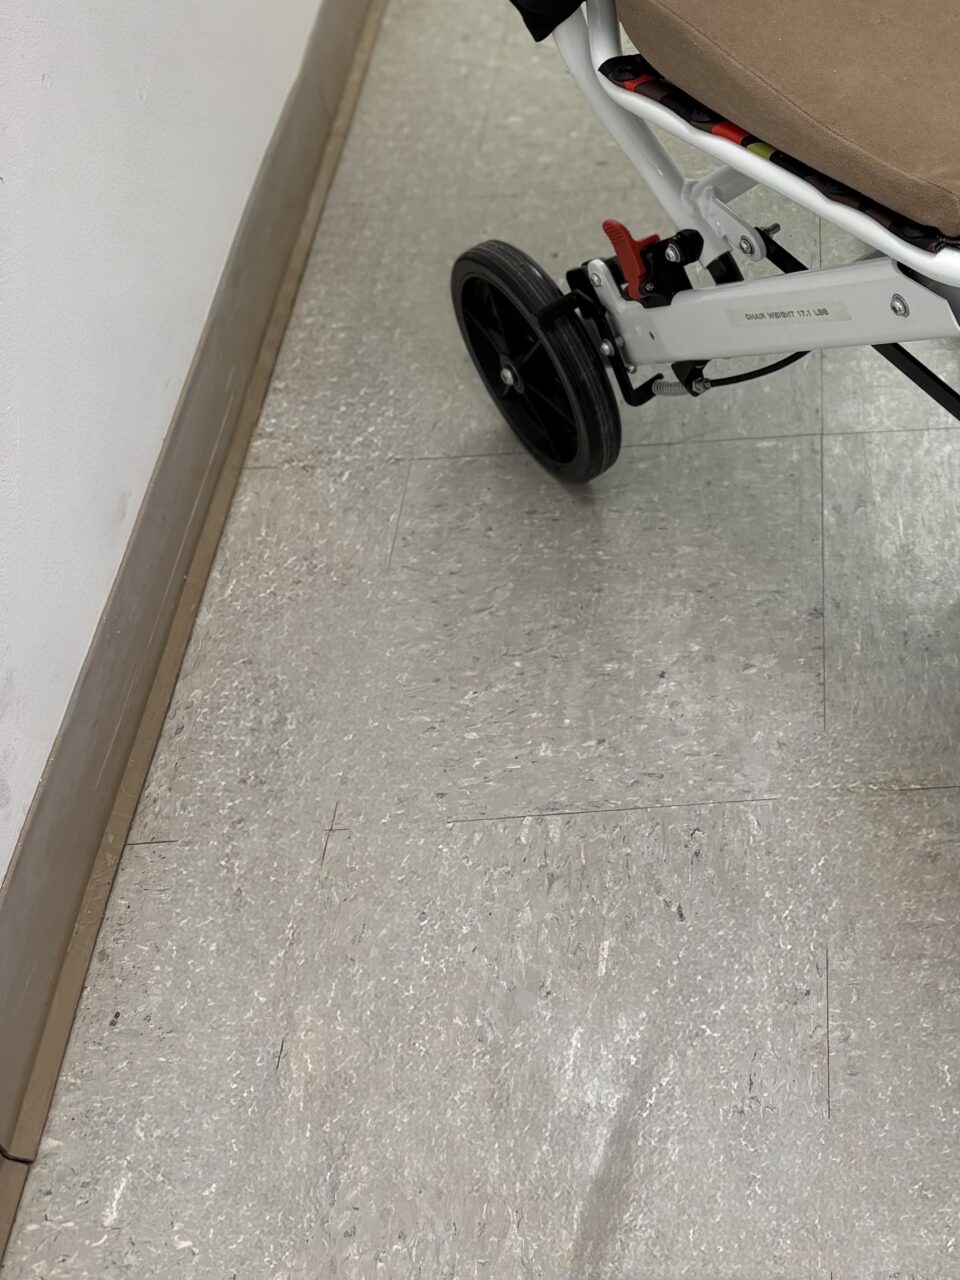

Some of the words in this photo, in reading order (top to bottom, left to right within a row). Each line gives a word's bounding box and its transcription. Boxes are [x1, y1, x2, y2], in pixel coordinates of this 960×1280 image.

[744, 312, 766, 320] CHAIR
[768, 310, 796, 319] WEIGHT
[797, 309, 812, 317] 17.1
[814, 308, 829, 316] LBS
